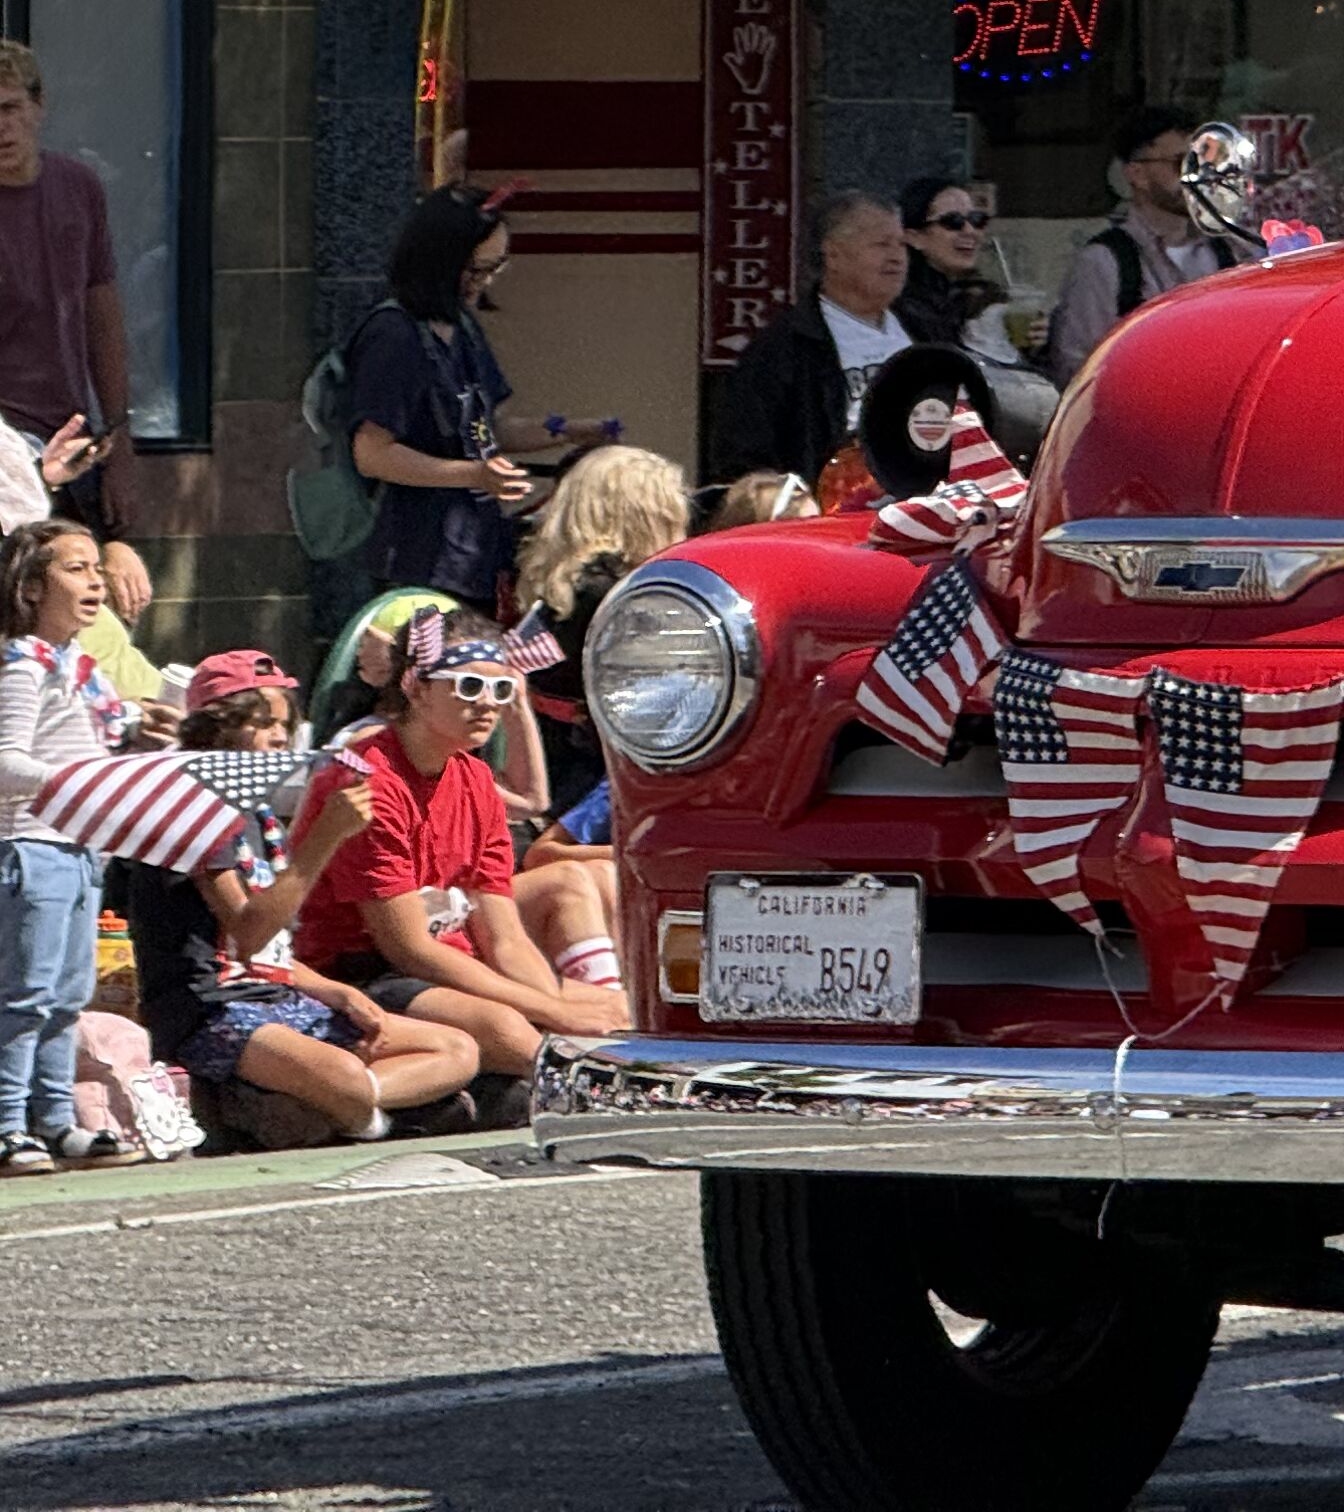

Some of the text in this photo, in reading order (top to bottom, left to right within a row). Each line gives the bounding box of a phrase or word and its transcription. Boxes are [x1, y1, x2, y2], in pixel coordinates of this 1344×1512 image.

[730, 101, 772, 328] TELLER
[757, 894, 868, 917] CALIFORNIA
[718, 934, 815, 956] HISTORICAL
[718, 964, 787, 987] VEHICLE
